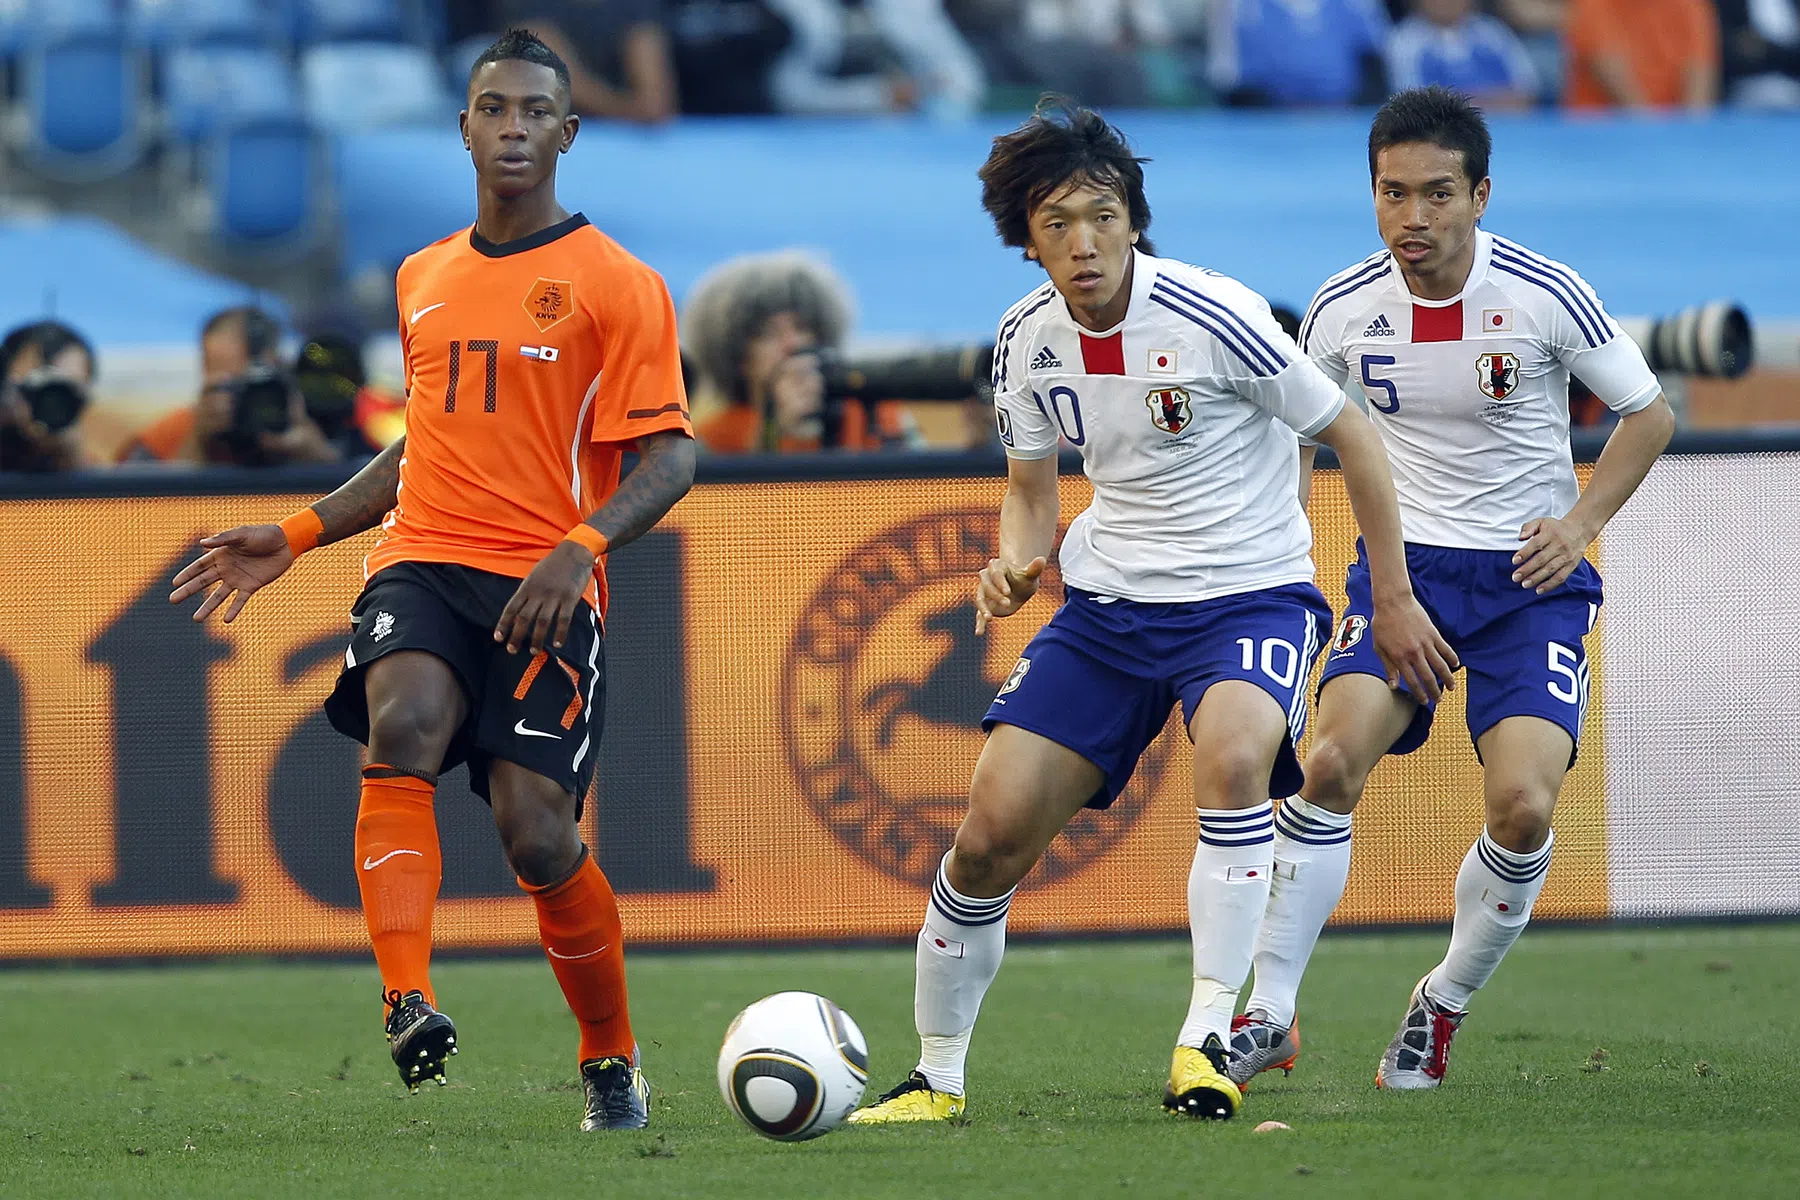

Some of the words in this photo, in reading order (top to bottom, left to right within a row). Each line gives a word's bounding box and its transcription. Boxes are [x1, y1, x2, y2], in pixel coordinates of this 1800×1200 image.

[1363, 327, 1396, 338] adidas
[445, 340, 499, 412] 17
[1030, 359, 1063, 370] adidas
[1361, 354, 1400, 414] 5
[1236, 636, 1300, 689] 10
[1546, 640, 1579, 705] 5
